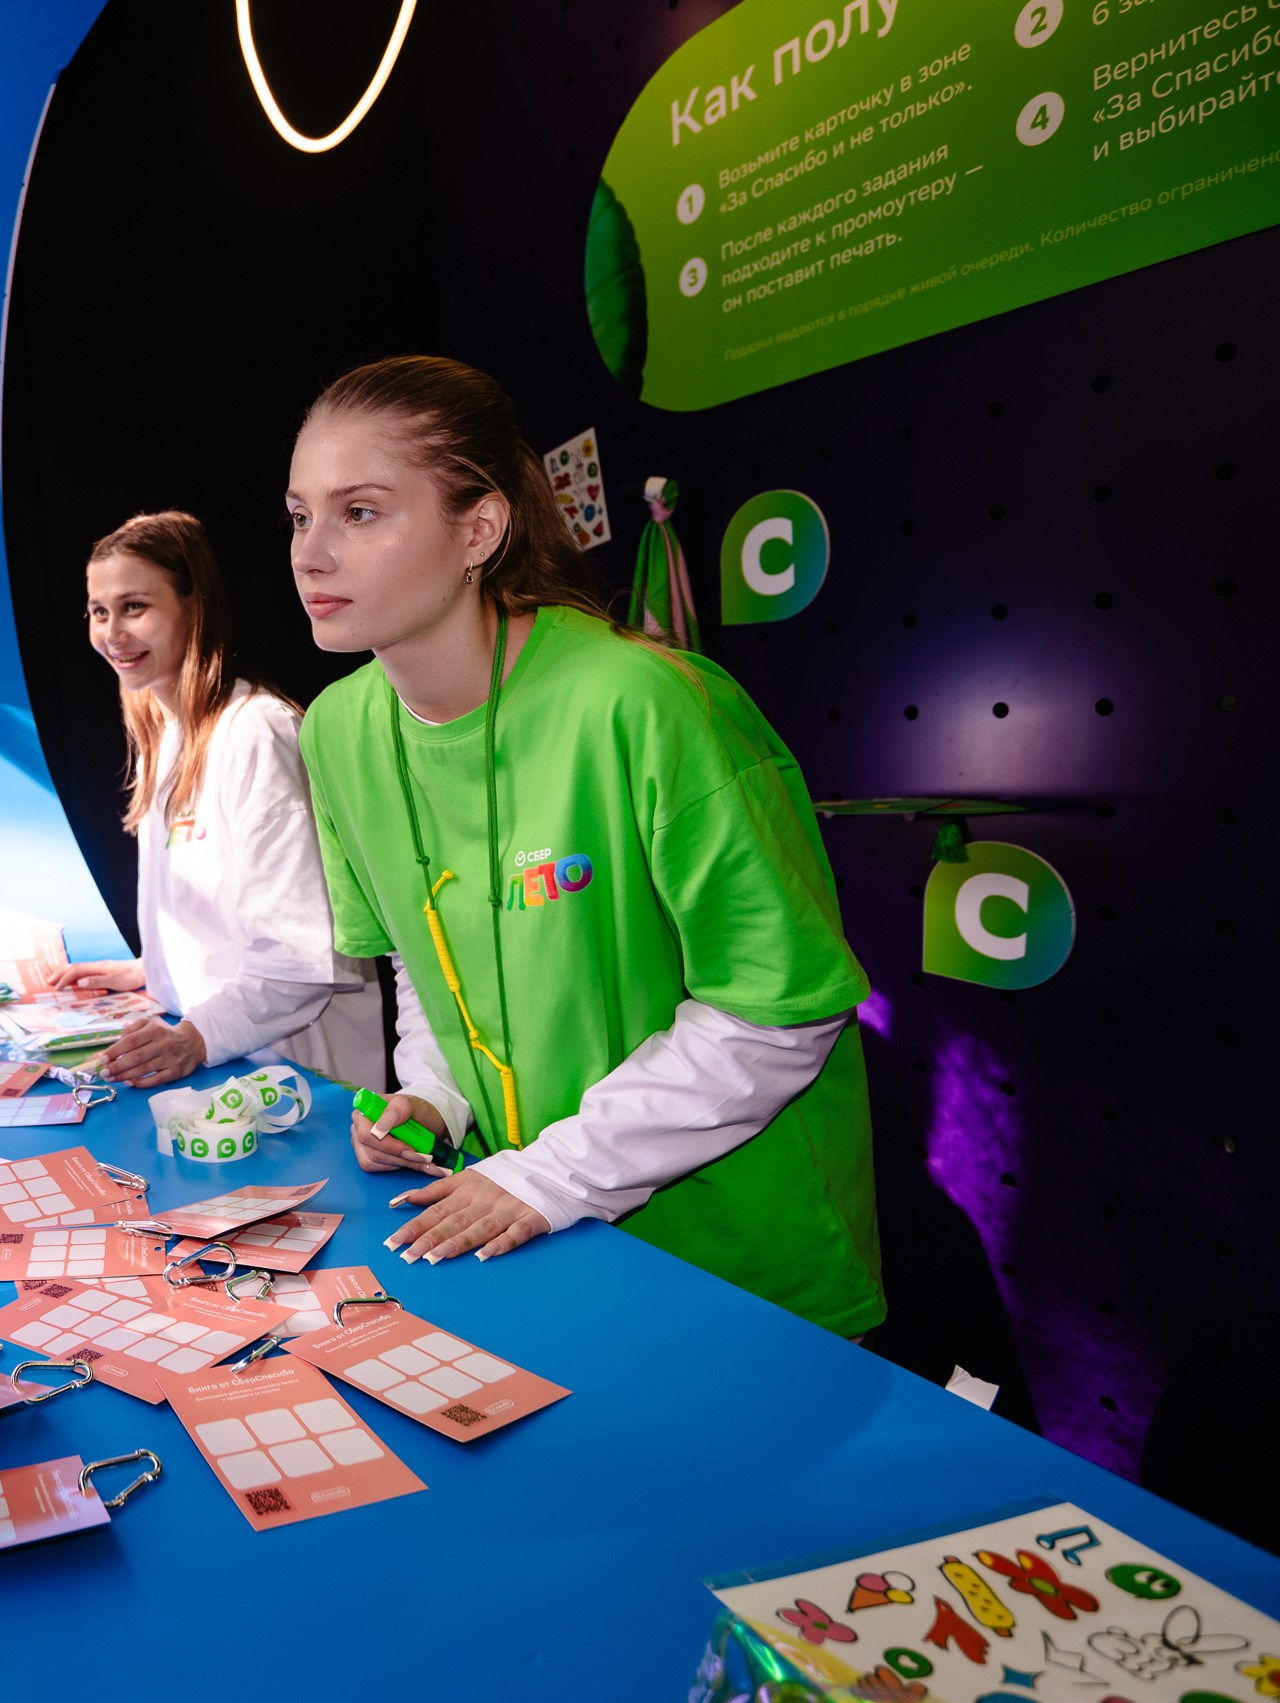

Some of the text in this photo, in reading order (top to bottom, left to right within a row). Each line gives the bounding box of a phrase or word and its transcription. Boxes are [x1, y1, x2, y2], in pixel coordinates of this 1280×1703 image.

[1030, 6, 1048, 37] 2
[1092, 0, 1110, 26] 6
[1093, 5, 1257, 91] Вернитесь
[671, 64, 758, 147] Как
[719, 43, 971, 189] Возьмите карточку в зоне
[720, 80, 972, 214] «За Спасибо и не только».
[1030, 103, 1050, 131] 4
[1092, 92, 1141, 125] «За
[1093, 71, 1280, 162] и выбирайт
[721, 145, 948, 262] После каждого задания
[722, 238, 811, 288] подходите
[816, 231, 826, 247] к
[832, 172, 957, 239] промоутеру
[722, 231, 902, 314] он поставит печать.
[848, 287, 906, 317] порядке
[909, 266, 957, 296] живой
[961, 241, 1035, 276] очереди.
[1040, 197, 1152, 247] Количество
[506, 853, 593, 912] ЛЕТО
[527, 847, 552, 862] СБЕР
[187, 1382, 218, 1394] Бинго
[232, 1369, 295, 1386] СберСпасибо
